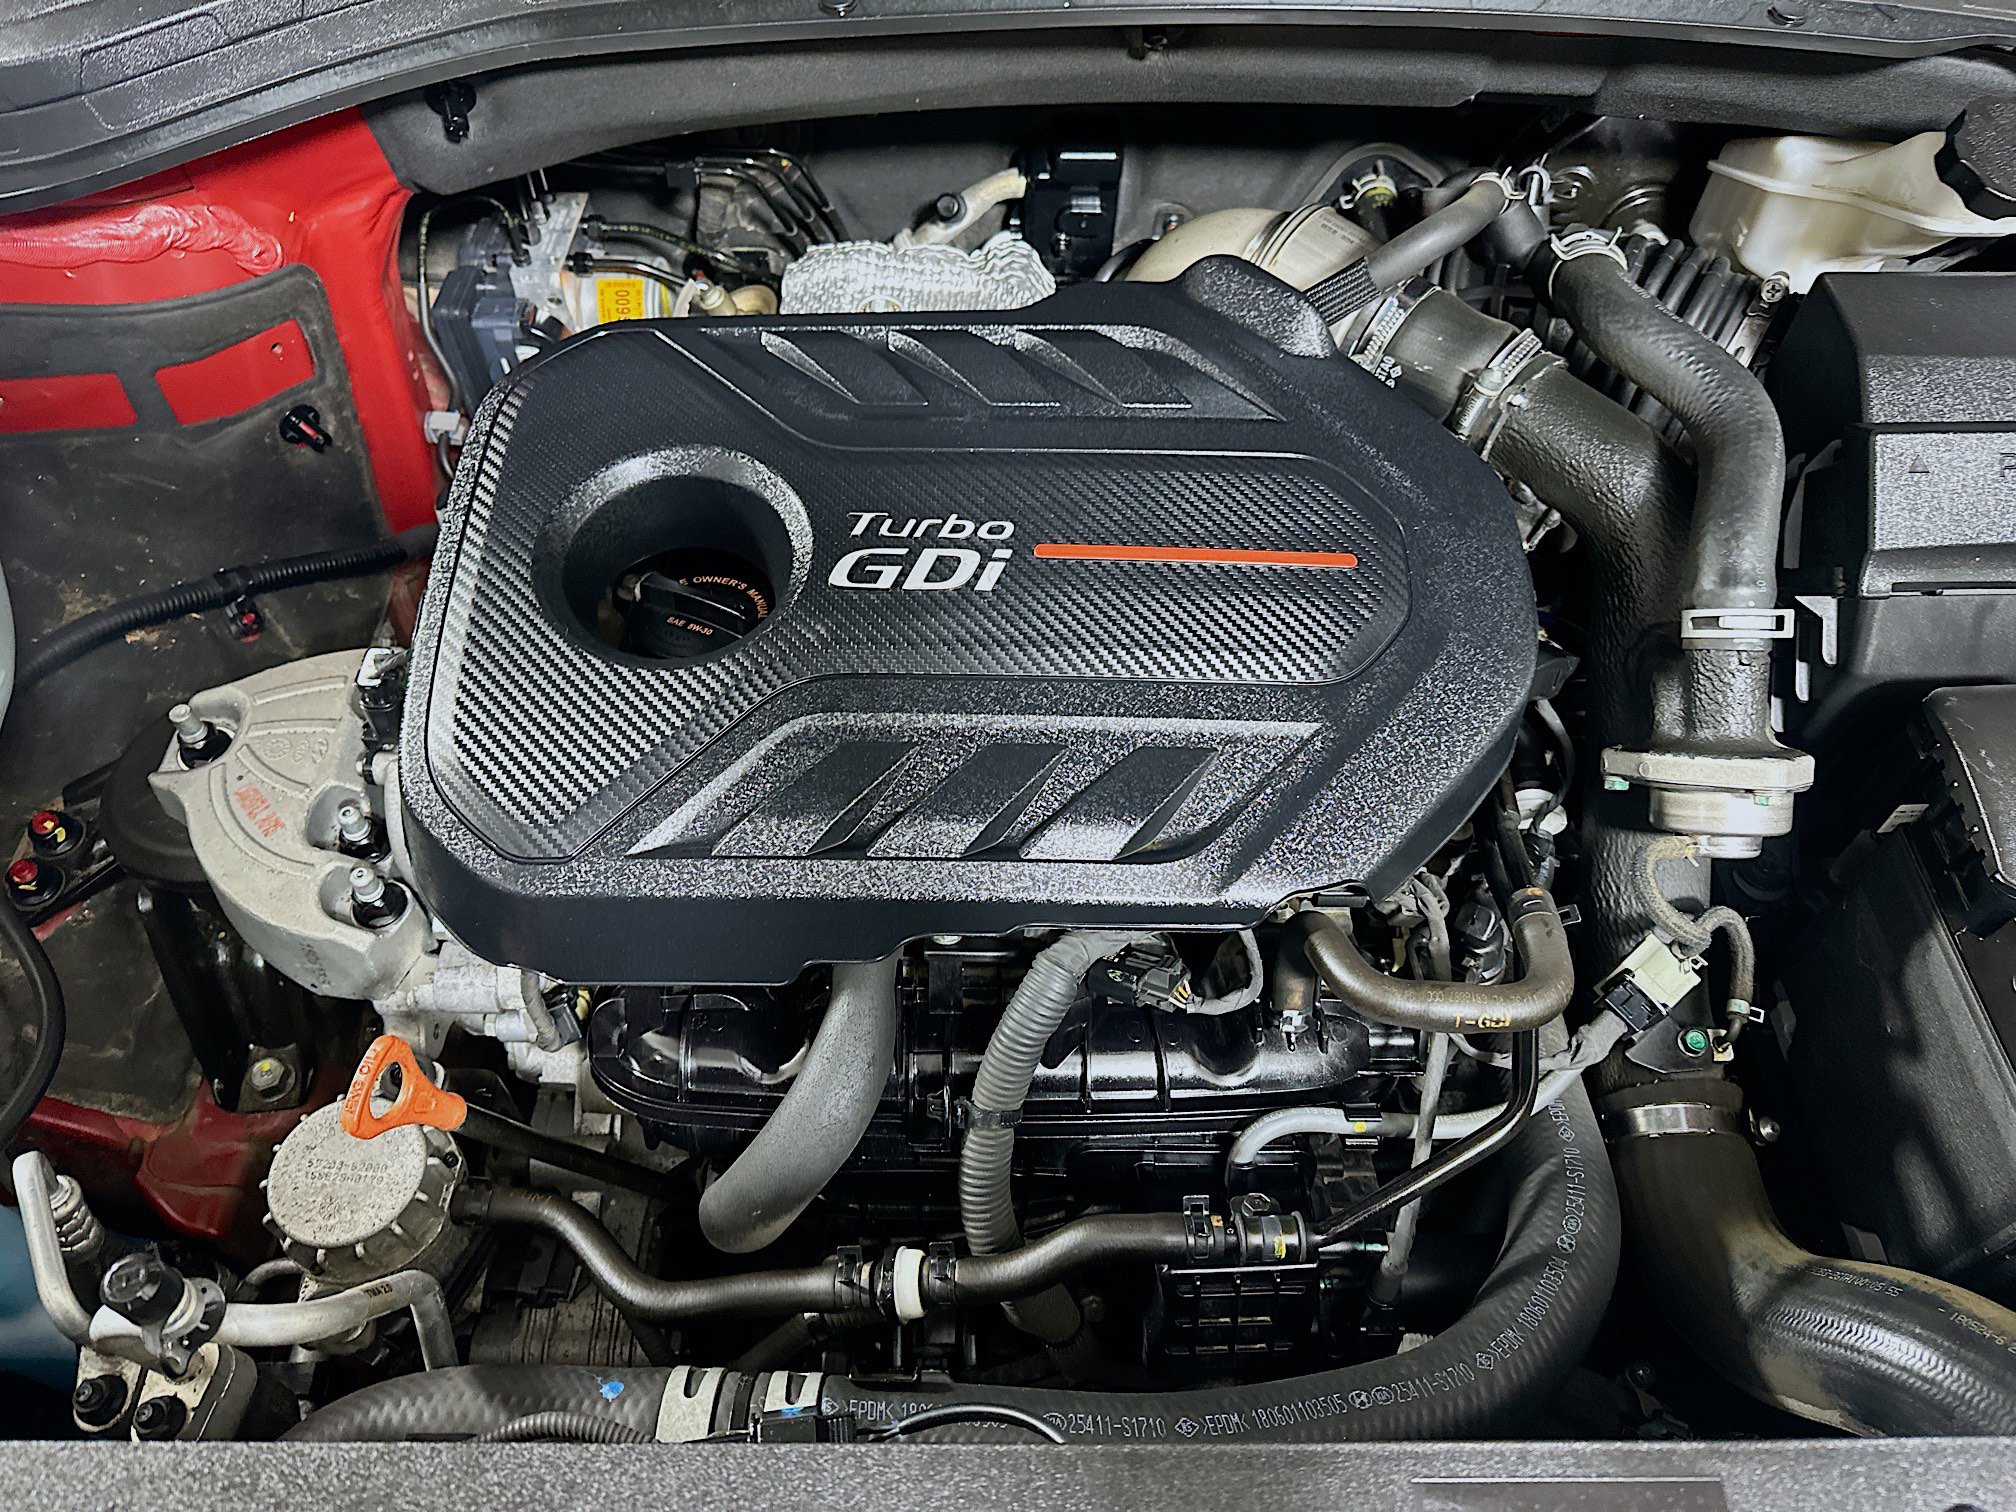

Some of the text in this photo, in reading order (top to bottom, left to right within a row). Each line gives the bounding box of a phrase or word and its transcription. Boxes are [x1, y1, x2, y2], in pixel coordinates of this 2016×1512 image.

[847, 512, 1015, 540] Turbo
[828, 547, 1014, 592] GDi
[693, 575, 748, 590] OWNER'S
[746, 588, 768, 619] MANUAL
[666, 616, 713, 636] SAE 5W-30
[344, 1045, 380, 1115] ENG OIL
[1563, 1147, 1586, 1217] 25411-S1710
[1068, 1413, 1166, 1438] 25411-S1710
[1252, 1393, 1347, 1431] 180601103505
[1391, 1362, 1475, 1403] 25411-S1710
